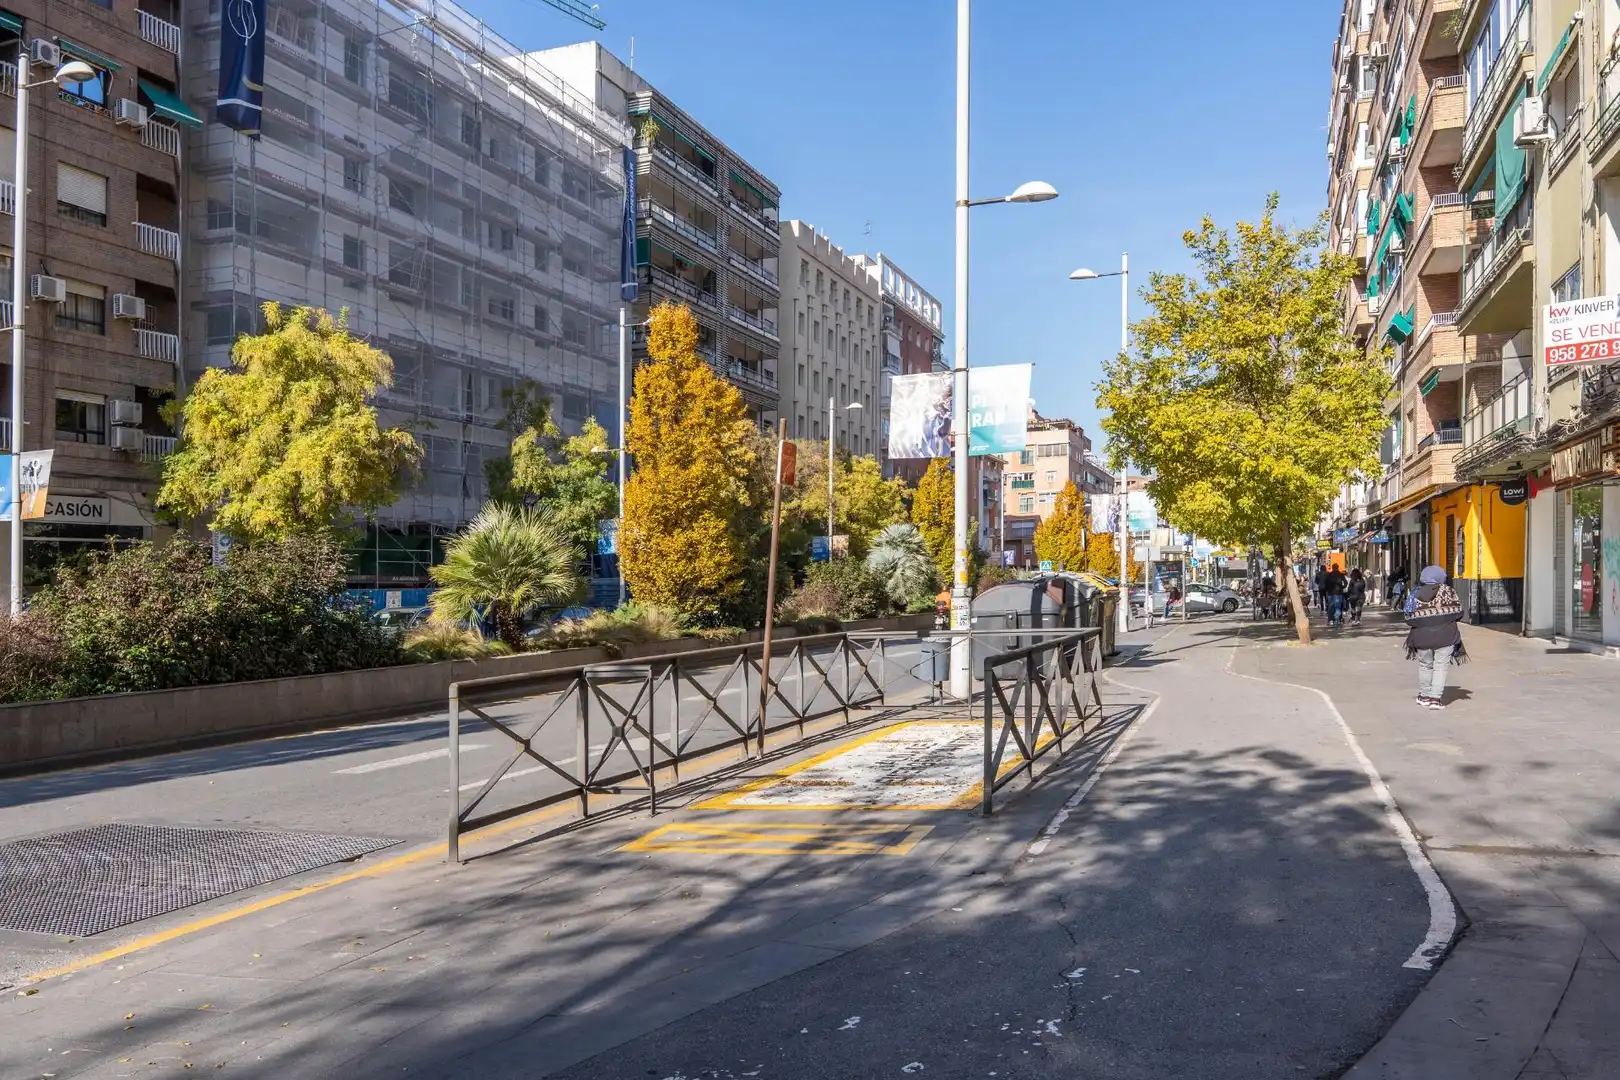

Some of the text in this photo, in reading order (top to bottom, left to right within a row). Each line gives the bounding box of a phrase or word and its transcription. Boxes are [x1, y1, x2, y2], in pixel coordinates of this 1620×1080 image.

[1574, 300, 1614, 315] KINVER
[1551, 327, 1573, 343] SE
[1549, 346, 1577, 363] 958
[1580, 342, 1609, 359] 278
